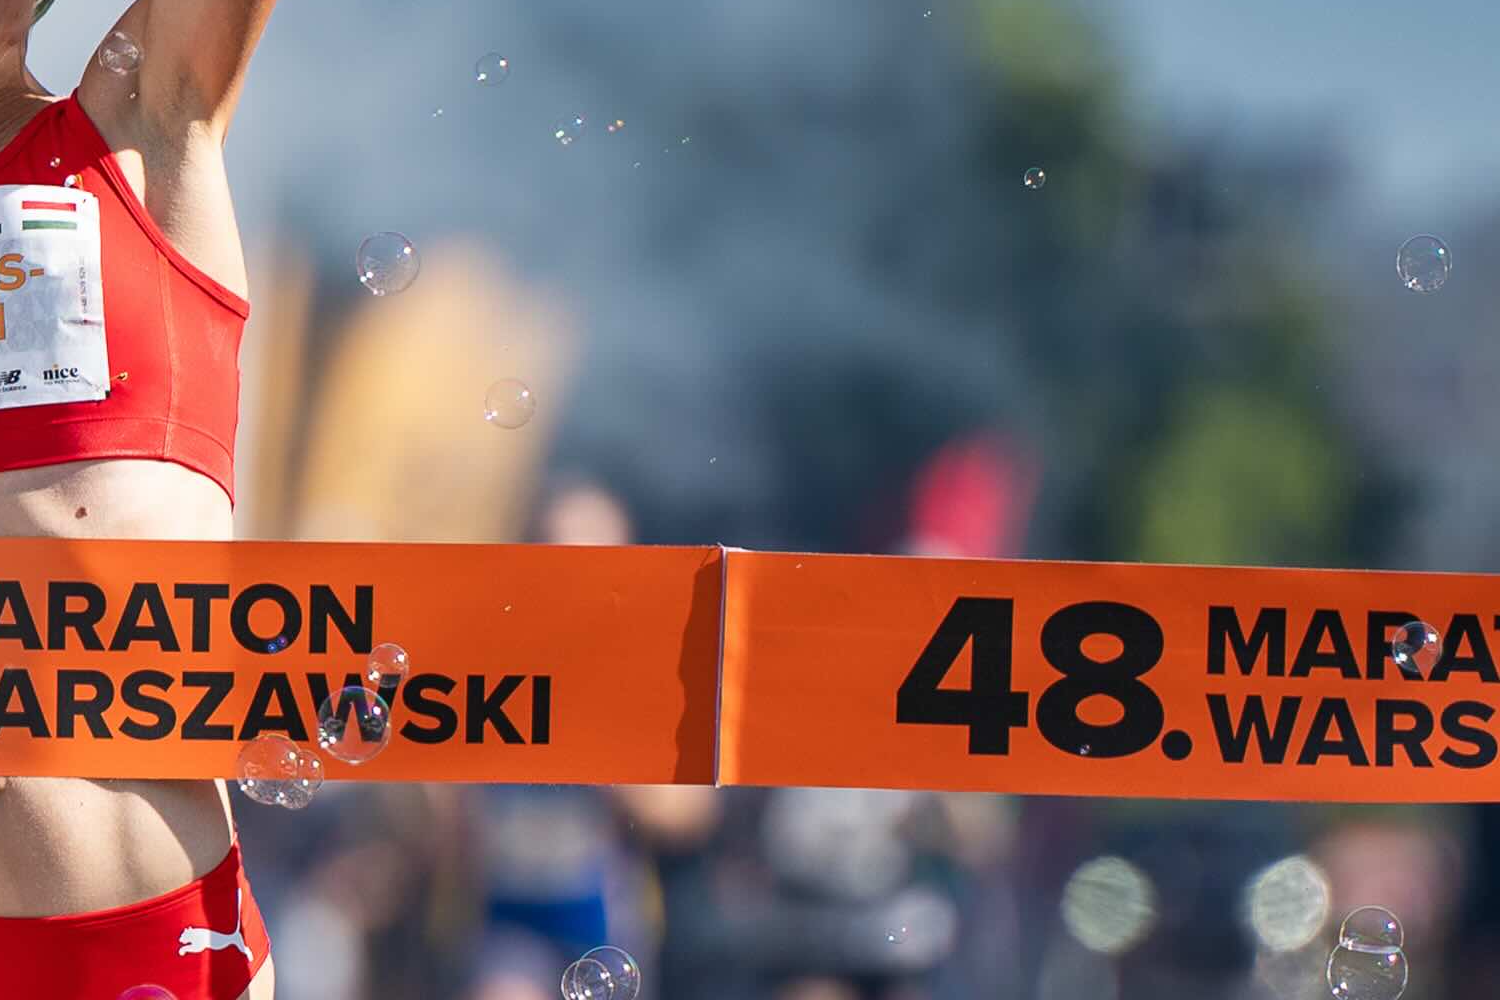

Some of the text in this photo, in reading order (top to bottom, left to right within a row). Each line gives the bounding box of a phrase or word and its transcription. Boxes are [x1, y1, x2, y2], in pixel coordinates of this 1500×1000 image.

[43, 363, 79, 380] nice
[896, 596, 1193, 761] 48.
[1207, 605, 1500, 684] MARA
[1206, 693, 1498, 769] WARS
